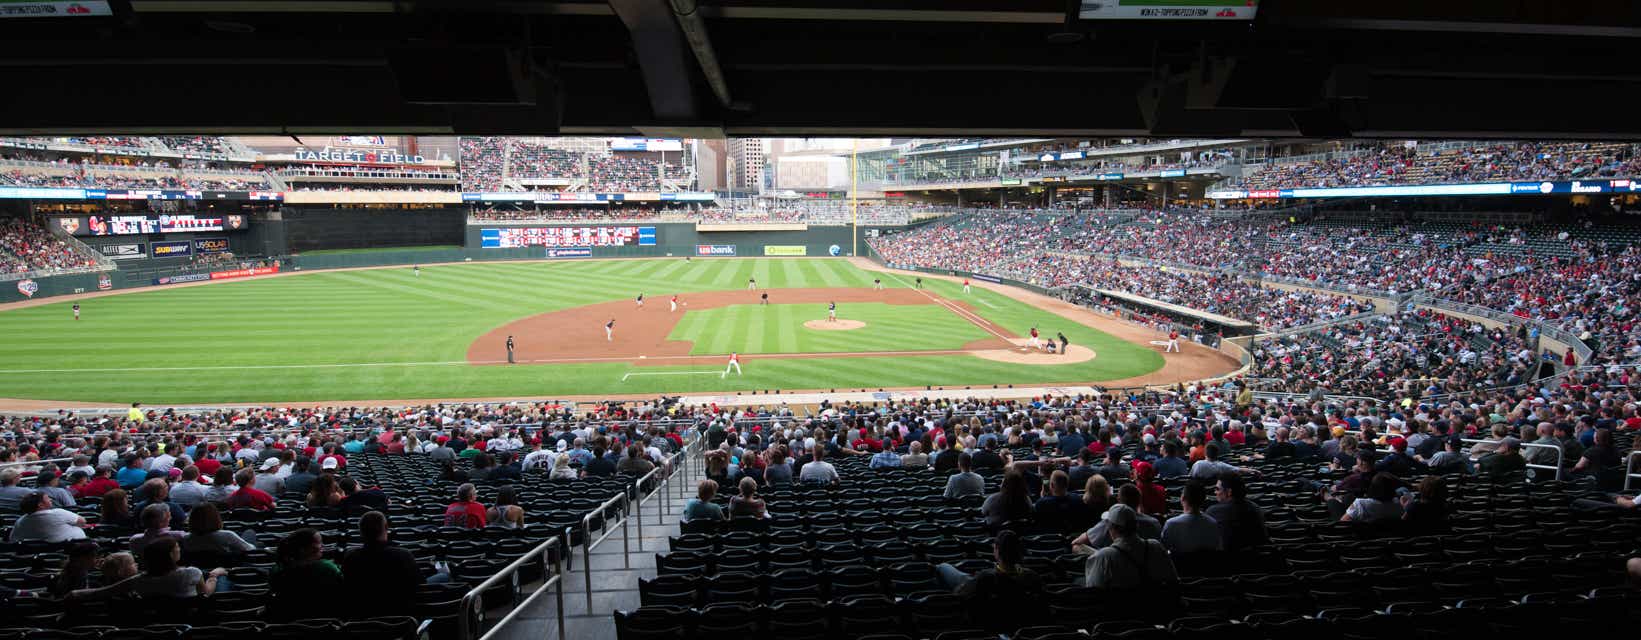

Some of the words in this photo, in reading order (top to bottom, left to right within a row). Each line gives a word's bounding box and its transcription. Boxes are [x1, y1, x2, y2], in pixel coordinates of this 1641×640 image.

[297, 150, 362, 162] TARGET
[380, 154, 425, 164] FIELD
[1571, 185, 1602, 193] ROSARIO
[154, 245, 188, 254] SUBWAY
